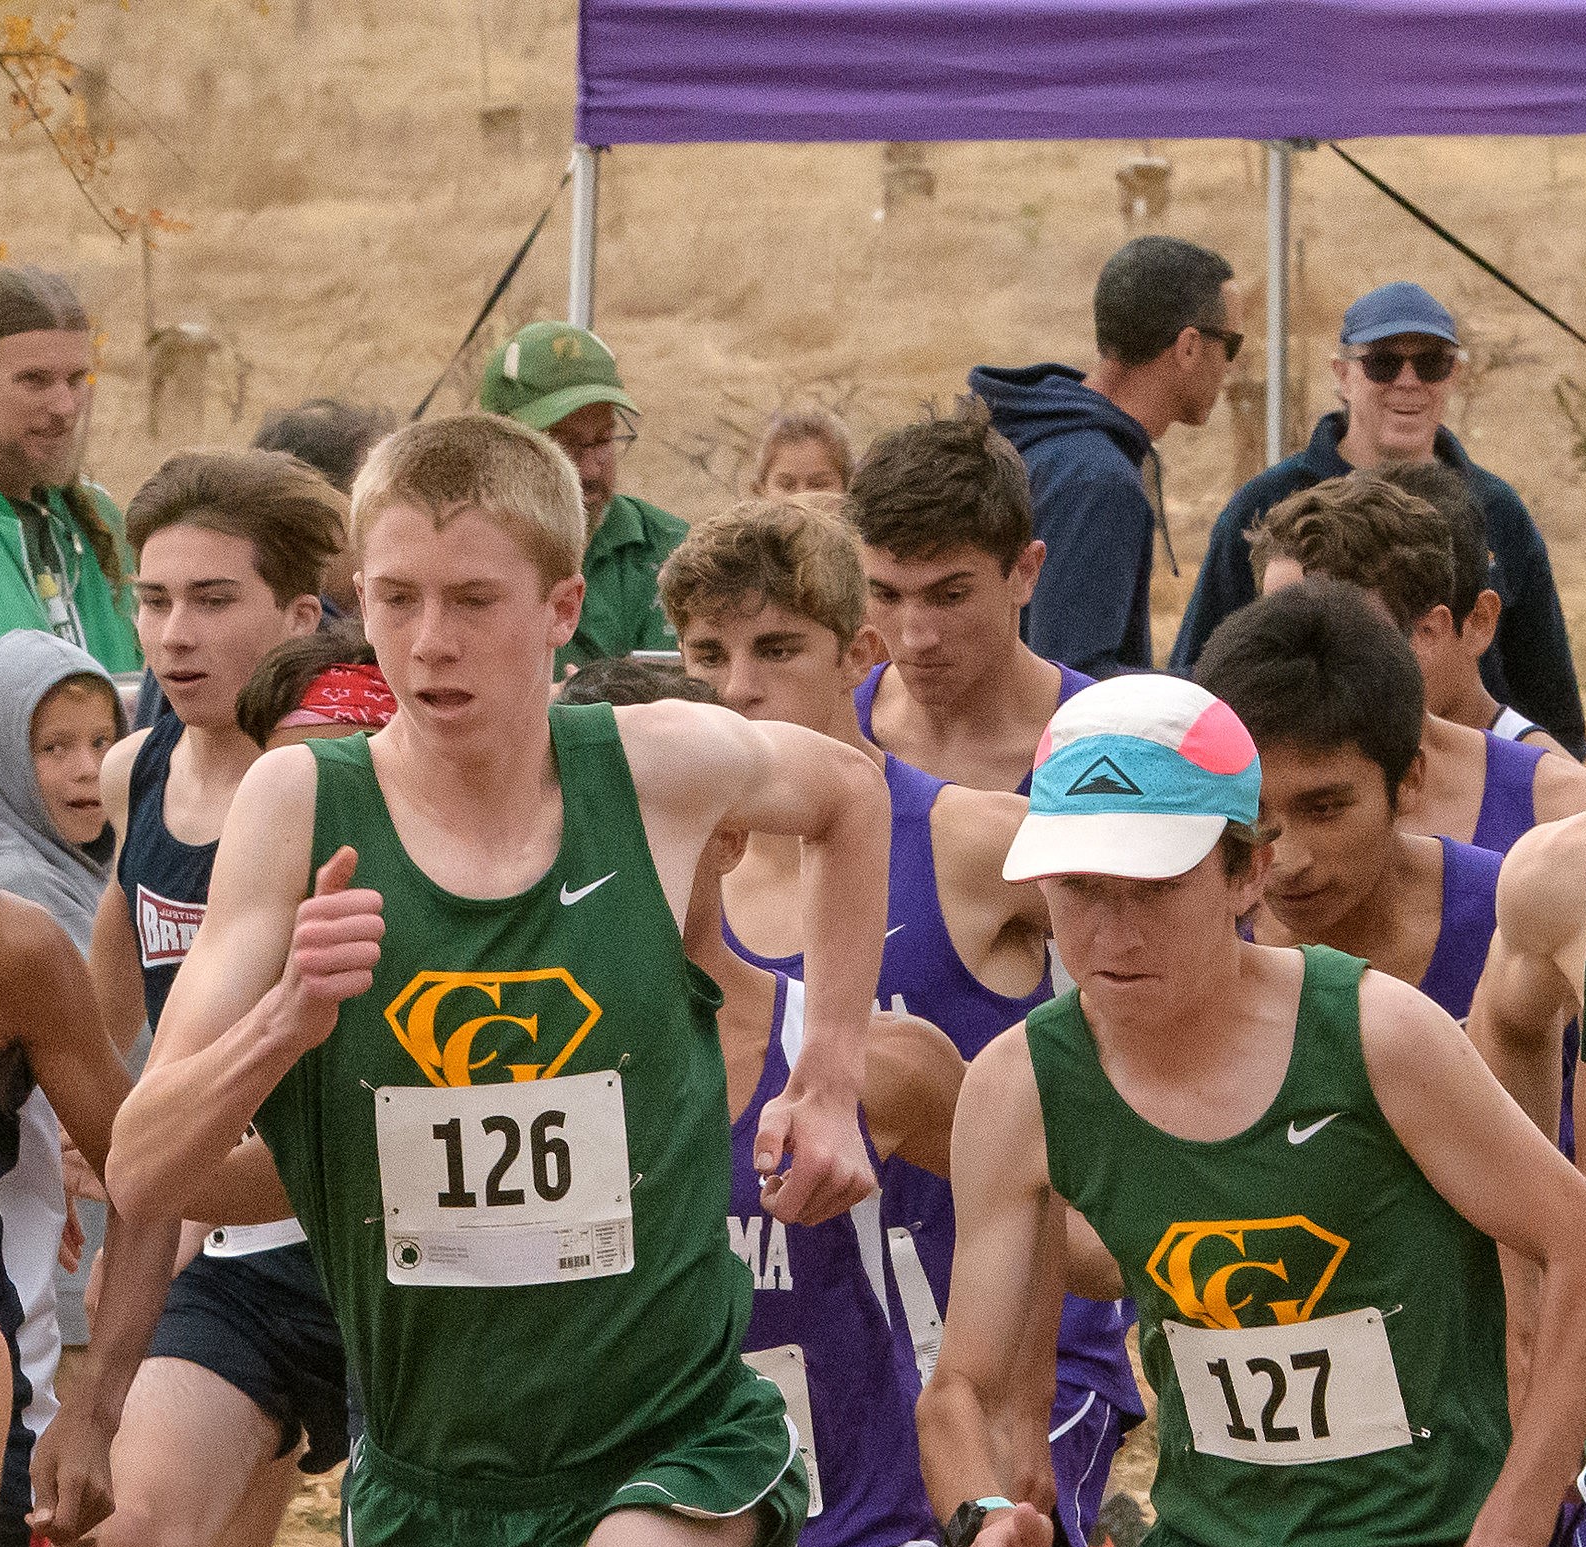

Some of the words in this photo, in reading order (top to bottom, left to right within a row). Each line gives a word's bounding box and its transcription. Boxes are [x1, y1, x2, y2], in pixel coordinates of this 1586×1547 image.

[143, 900, 202, 953] BRA
[159, 907, 207, 920] JUSTIN-
[432, 1109, 572, 1208] 126
[1205, 1348, 1332, 1443] 127
